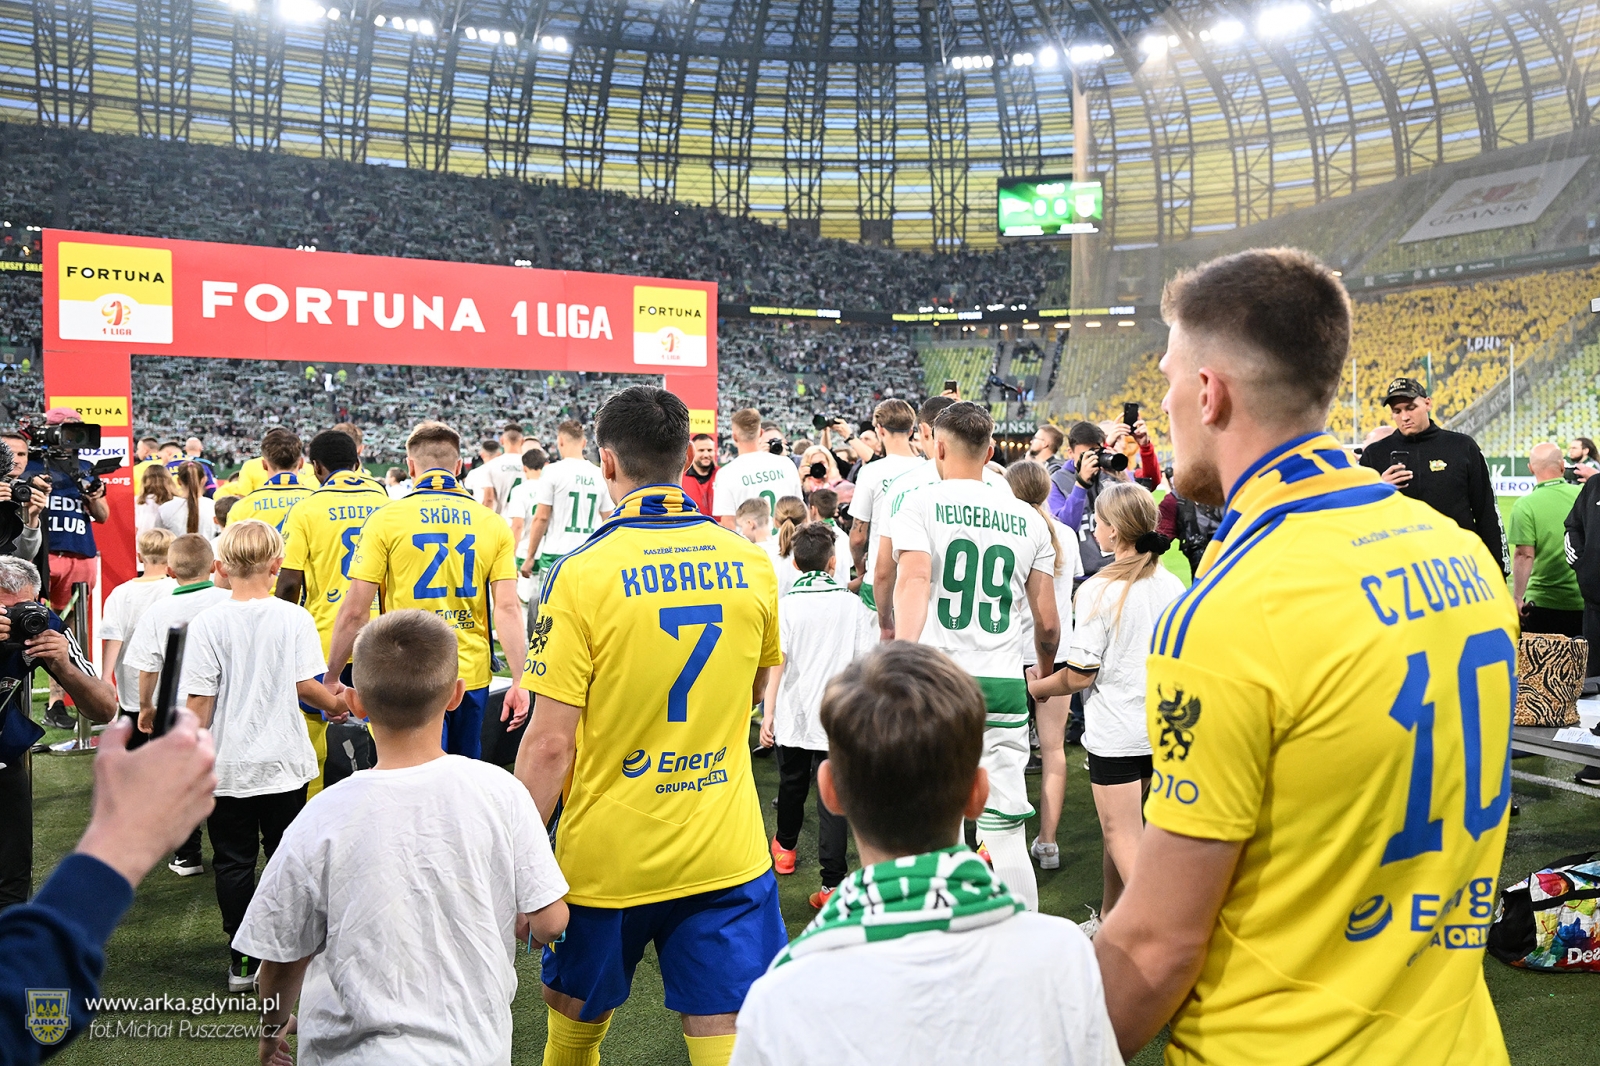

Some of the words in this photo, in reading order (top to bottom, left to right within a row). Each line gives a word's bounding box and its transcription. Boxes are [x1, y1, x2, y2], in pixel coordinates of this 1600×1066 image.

[66, 266, 165, 284] FORTUNA
[202, 280, 486, 333] FORTUNA
[511, 300, 528, 336] 1
[537, 301, 613, 341] LIGA
[639, 305, 702, 318] FORTUNA
[110, 328, 132, 336] LIGA
[75, 407, 122, 415] RTUNA
[994, 420, 1035, 434] DAŃSK
[78, 448, 126, 456] UZUKI
[575, 474, 595, 486] PIŁA
[741, 469, 784, 486] OLSSON
[46, 495, 85, 513] EDI
[254, 496, 304, 511] MILEWS
[564, 491, 597, 534] 11
[935, 502, 1027, 538] NEUGEBAUER
[412, 533, 477, 599] 21
[621, 561, 749, 597] KOBACKI
[938, 538, 1015, 634] 99
[1361, 554, 1495, 627] CZUBAK
[659, 604, 723, 723] 7
[1379, 627, 1517, 865] 10
[655, 781, 696, 794] GRUPA
